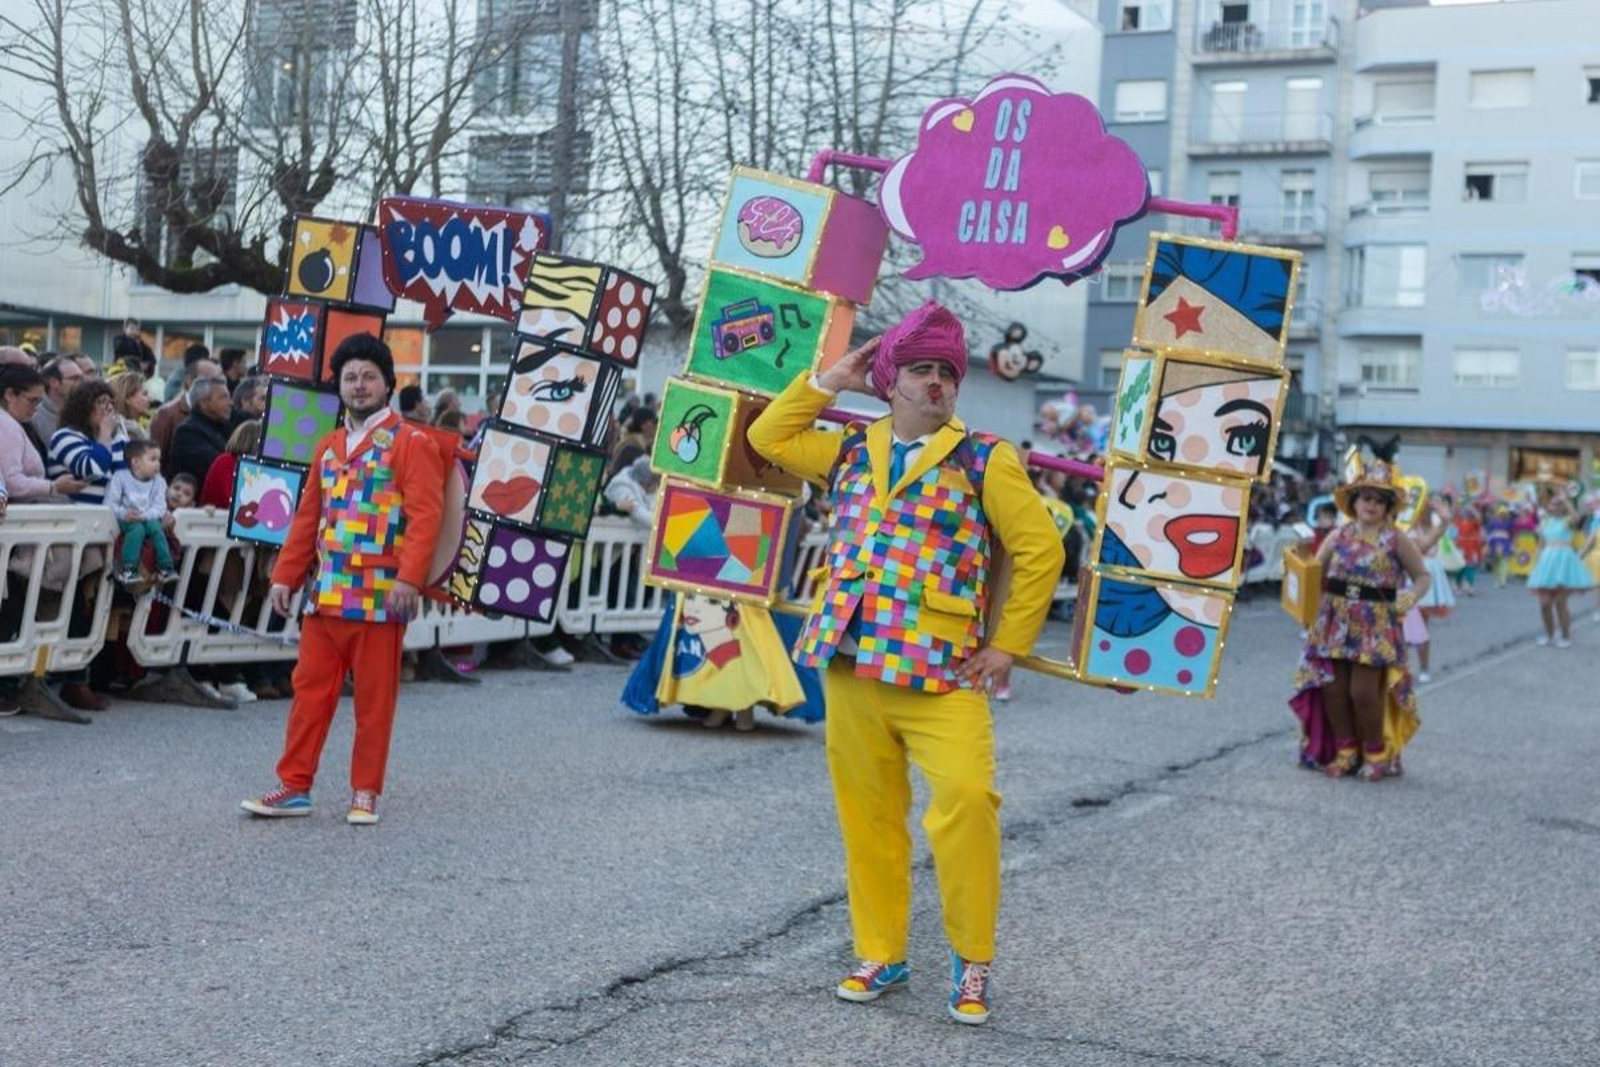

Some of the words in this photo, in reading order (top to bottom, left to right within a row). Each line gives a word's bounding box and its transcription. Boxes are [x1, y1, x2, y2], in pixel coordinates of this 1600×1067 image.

[995, 98, 1032, 142] OS
[984, 147, 1022, 191] DA
[958, 199, 1028, 244] CASA
[387, 218, 514, 287] BOOM!
